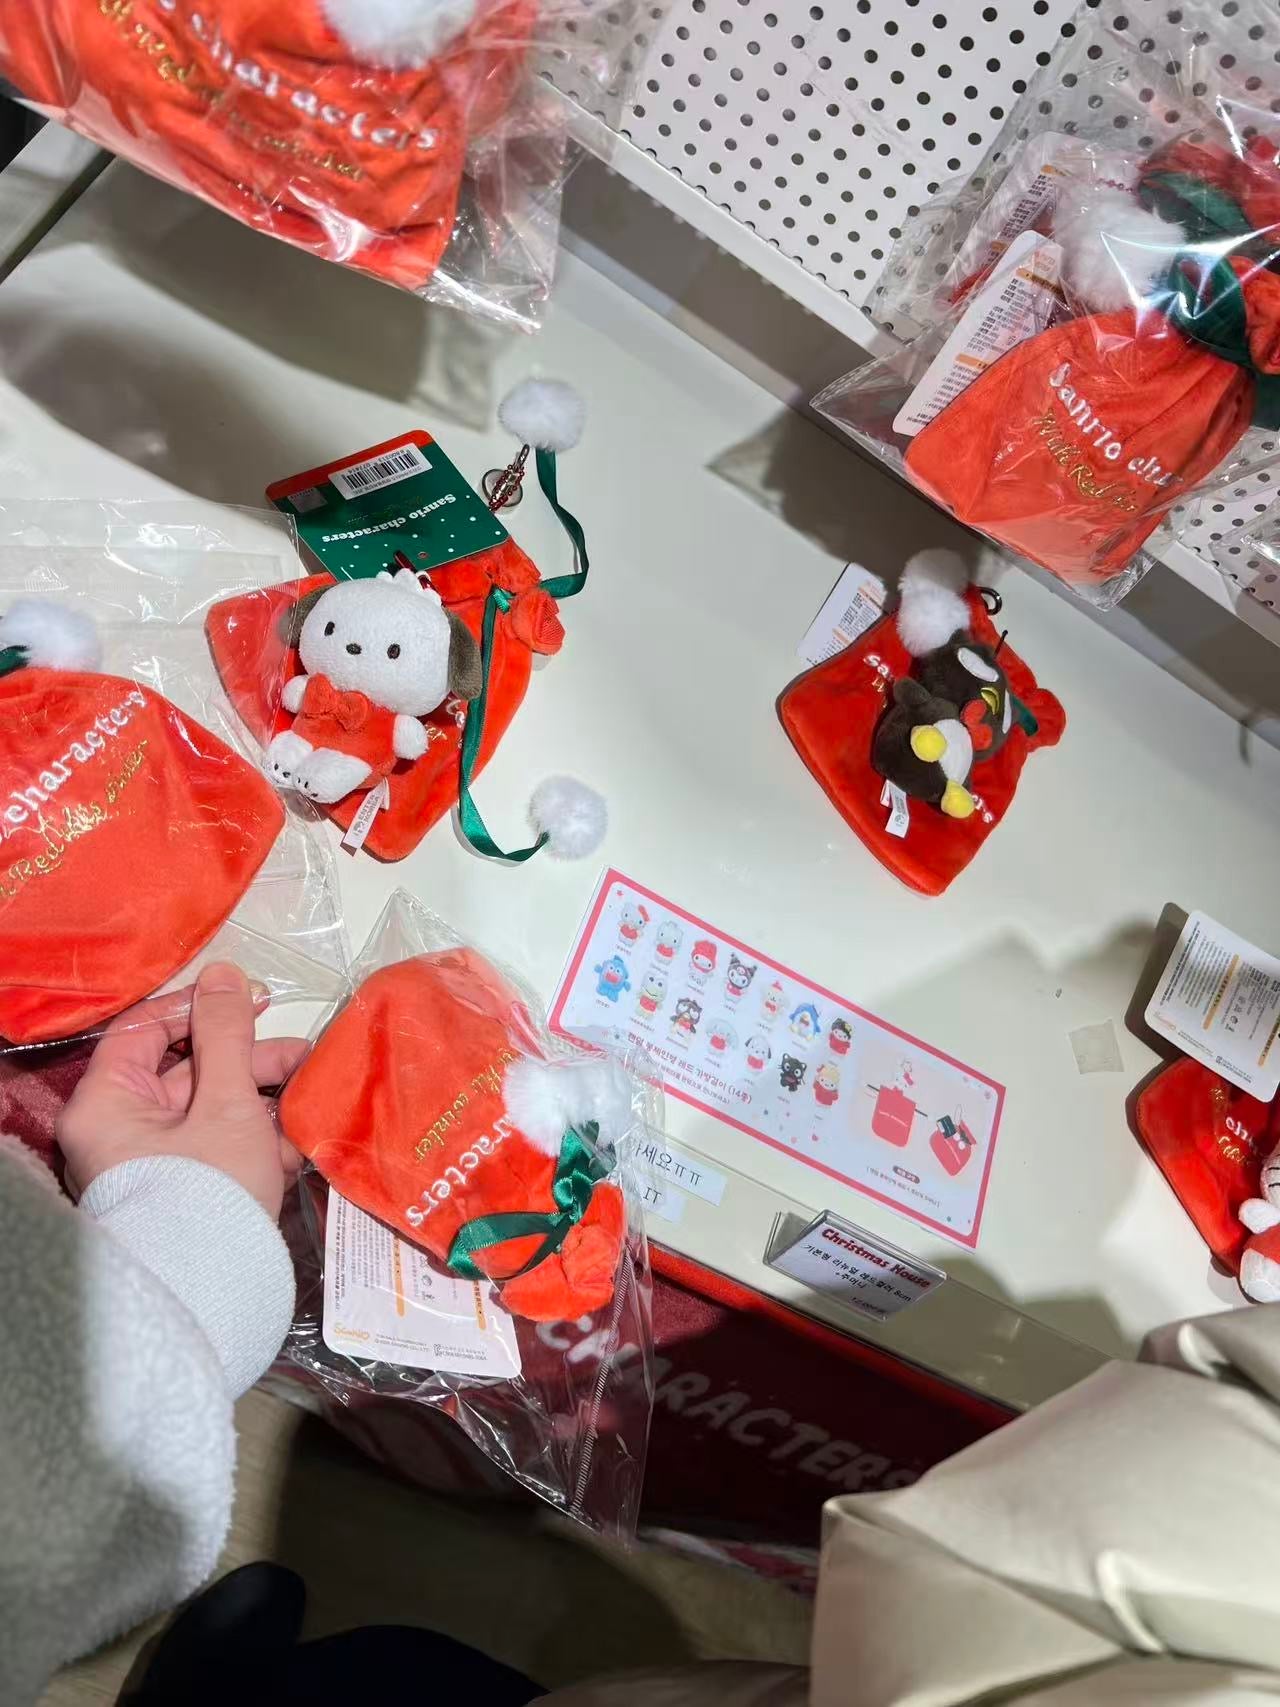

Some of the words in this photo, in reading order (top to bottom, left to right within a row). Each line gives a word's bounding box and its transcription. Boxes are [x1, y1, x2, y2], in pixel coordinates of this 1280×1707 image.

[408, 493, 456, 519] Sanrio
[322, 516, 406, 542] characters
[677, 1060, 694, 1074] 레드
[694, 1068, 726, 1090] 가방걸이
[414, 1092, 470, 1162] winter
[822, 1228, 888, 1268] Christmas
[891, 1263, 930, 1288] House
[832, 1258, 859, 1273] 리뉴얼
